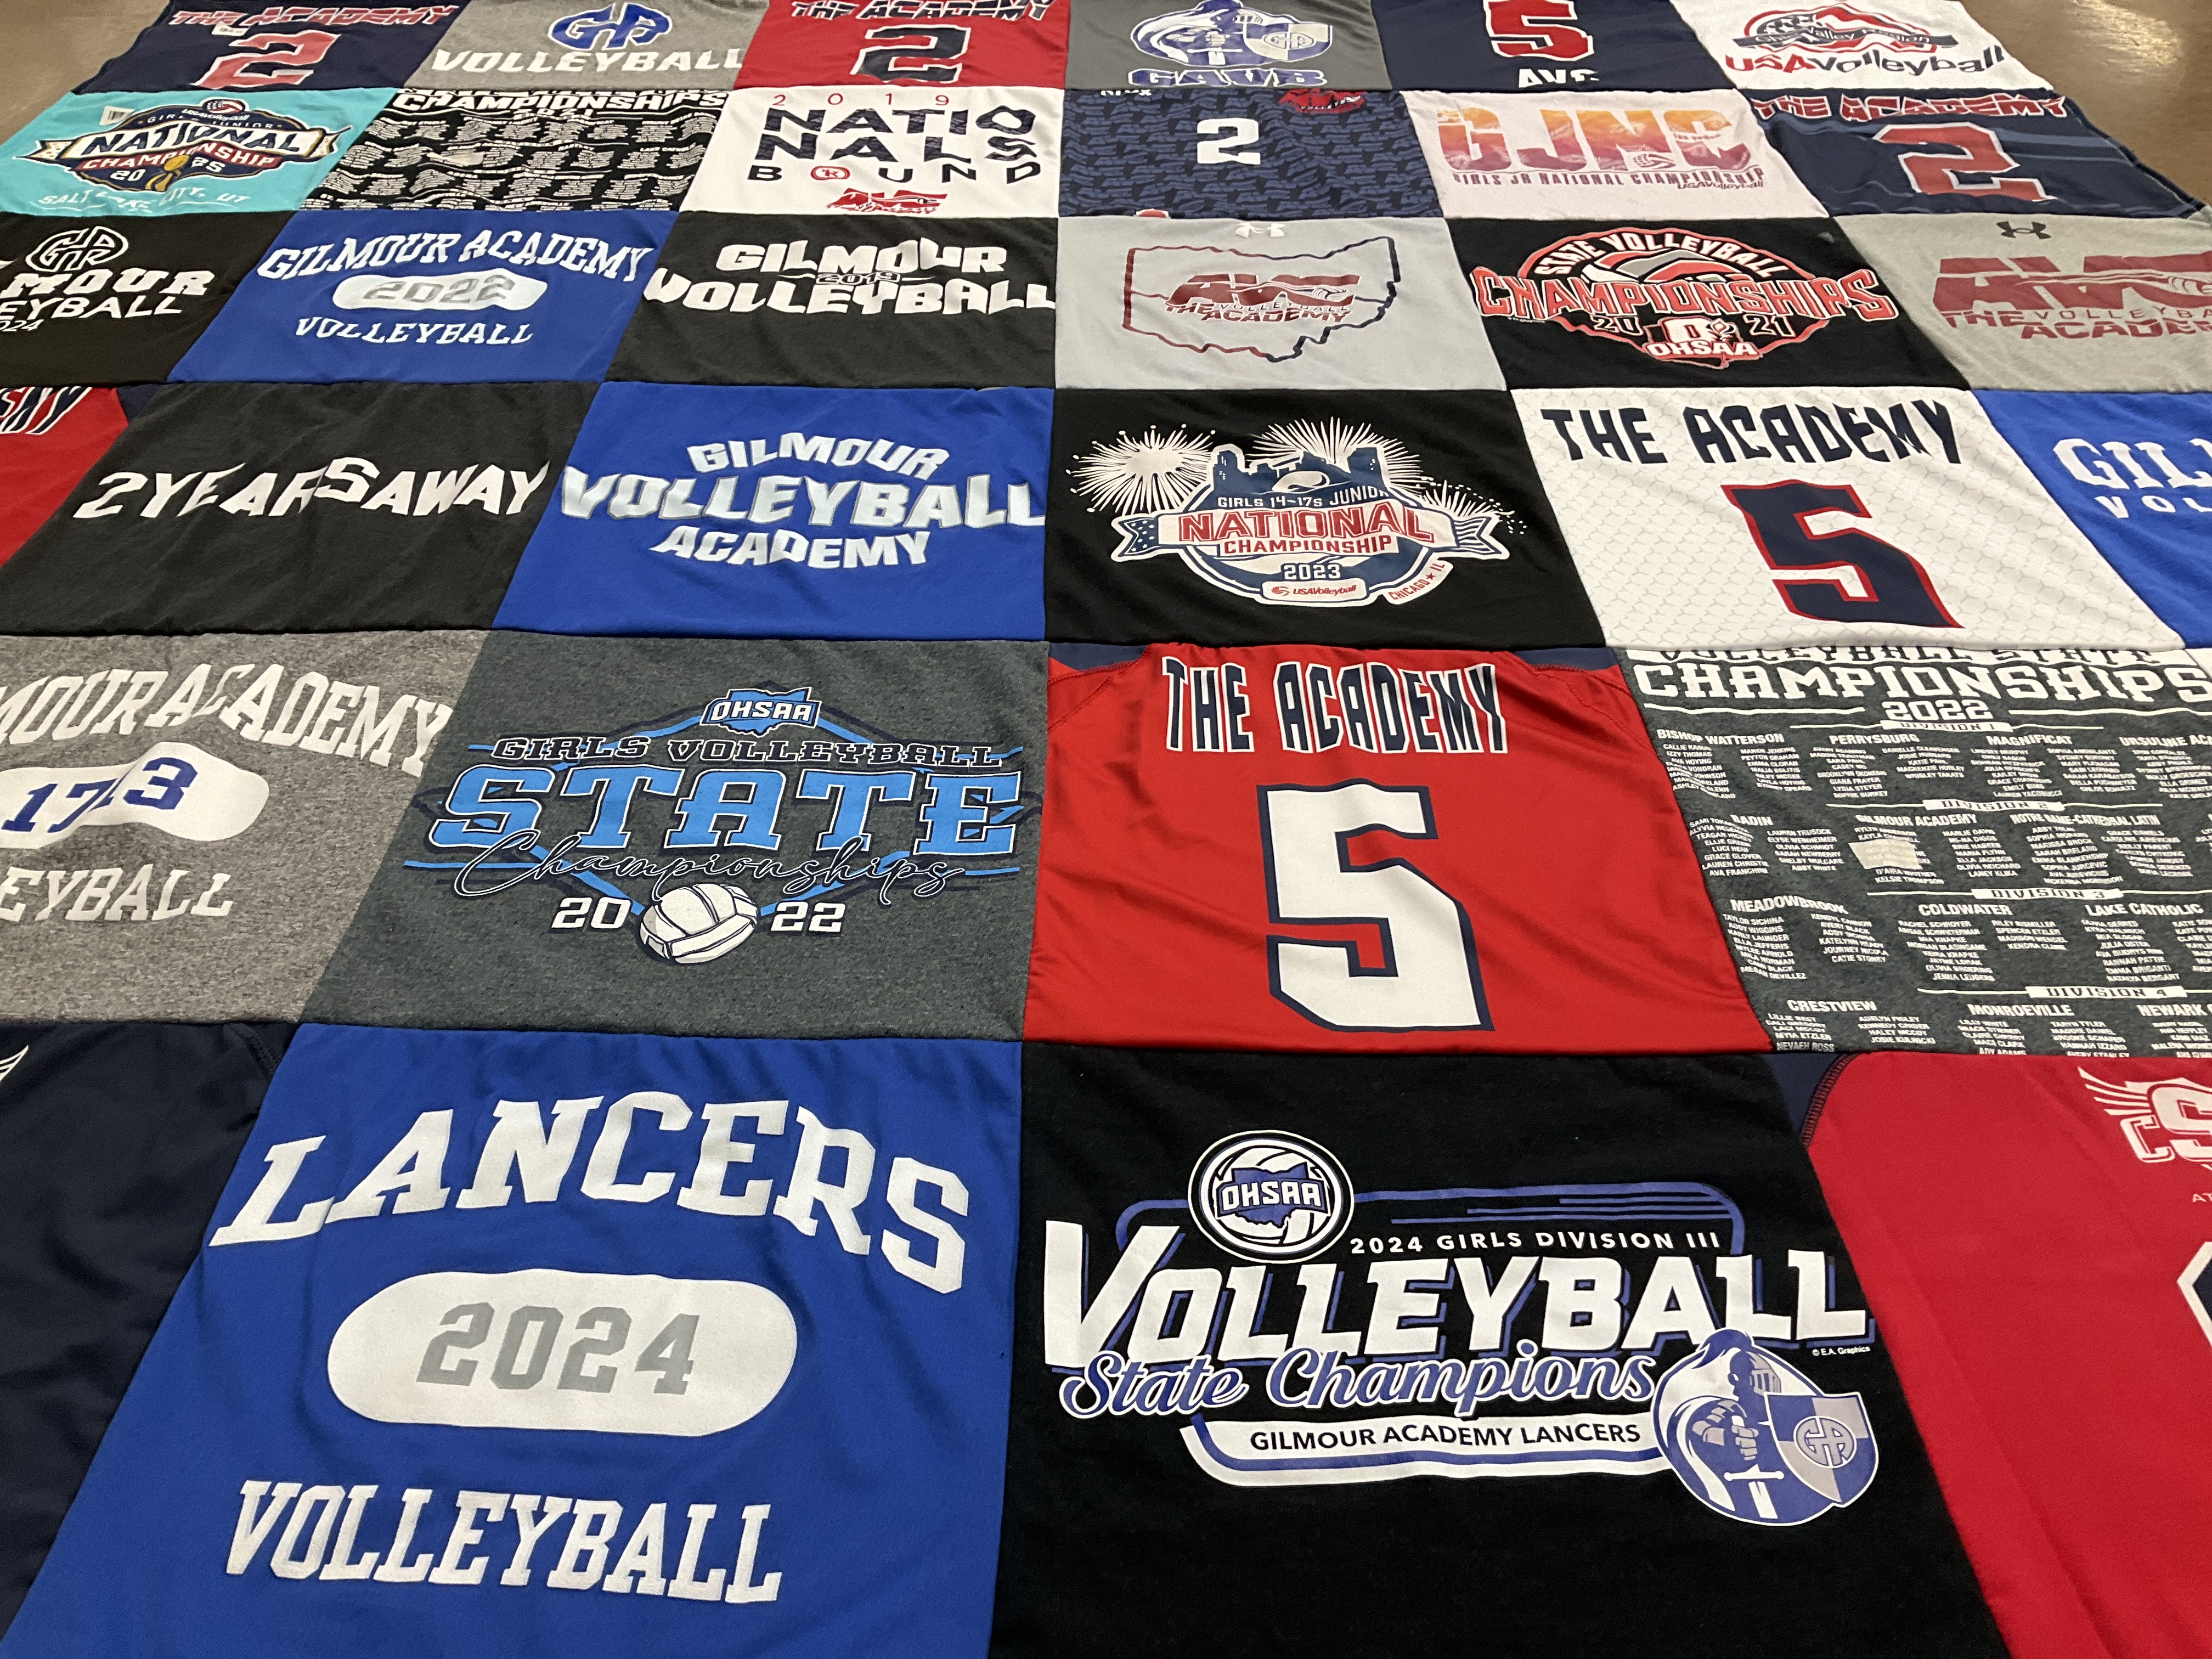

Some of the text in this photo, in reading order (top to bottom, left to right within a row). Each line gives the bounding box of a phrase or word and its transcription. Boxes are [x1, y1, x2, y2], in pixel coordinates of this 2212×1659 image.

[169, 5, 460, 26] THE ACADEMY
[791, 0, 1054, 21] THE ACADEMY
[1483, 0, 1594, 61] 5
[190, 29, 341, 89] 2
[431, 48, 743, 72] VOLLEYBALL
[850, 24, 970, 83] 2
[393, 92, 729, 110] CHAMPIONSHIPS
[1752, 93, 2067, 122] THE ACADEMY
[81, 125, 301, 155] NATIONAL
[1197, 117, 1261, 165] 2
[1871, 121, 2059, 202] 2
[110, 169, 145, 181] 20
[1510, 172, 1532, 185] JR
[1539, 173, 1624, 185] NATIONAL
[38, 189, 93, 204] SALT
[217, 193, 251, 203] UT
[257, 230, 655, 282] GILMOUR ACADEMY
[715, 237, 1007, 273] GILMOUR
[1535, 233, 1790, 279] STATE VOLLEYBALL
[363, 274, 514, 304] 2022
[815, 271, 901, 285] 2019
[642, 268, 1056, 315] VOLLEYBALL
[1470, 266, 1899, 323] CHAMPIONSHIPS
[1165, 303, 1353, 323] THE ACADEMY
[1592, 313, 1796, 337] 20 21
[1941, 311, 2029, 328] THE
[296, 317, 533, 345] VOLLEYBALL
[1647, 341, 1758, 356] OHSAA
[1541, 399, 1962, 465] THE ACADEMY
[686, 432, 950, 481] GILMOUR
[561, 466, 1046, 529] VOLLEYBALL
[1217, 496, 1263, 507] GIRLS
[1178, 504, 1435, 544] NATIONAL
[650, 526, 931, 569] ACADEMY
[1223, 534, 1392, 555] CHAMPIONSHIP
[1719, 478, 1966, 629] 5
[1283, 563, 1342, 580] 2023
[1388, 579, 1429, 601] CHICAGO
[1634, 662, 2212, 703] CHAMPIONSHIPS
[710, 699, 813, 724] OHSAA
[1161, 655, 1508, 754] THE ACADEMY
[1882, 700, 1994, 721] 2022
[144, 663, 454, 777] ACADEMY
[1900, 722, 1987, 731] DIVISION
[1656, 729, 1785, 745] BISHOP WATTERSON
[1829, 733, 1920, 744] PERRYSBURG
[1985, 735, 2073, 746] MAGNIFICAT
[2119, 736, 2188, 747] URSULINE
[491, 736, 1003, 769] GIRLS VOLLEYBALL
[428, 763, 1022, 856] STATE
[1940, 800, 2024, 809] DIVISION
[1730, 814, 1774, 826] BADIN
[1855, 814, 1978, 826] GILMOUR ACADEMY
[2010, 814, 2045, 825] NOTRE
[2130, 815, 2161, 825] LATIN
[454, 828, 965, 906] Championships
[1255, 777, 1495, 1031] 5
[1730, 895, 1849, 915] MEADOWBROOK
[1991, 890, 2085, 899] DIVISION
[550, 897, 847, 935] 20 22
[1918, 904, 2013, 916] COLDWATER
[2085, 902, 2204, 916] LAKE CATHOLIC
[2046, 988, 2148, 997] DIVISION
[1787, 1000, 1877, 1012] CRESTVIEW
[1967, 1004, 2075, 1017] MONROEVILLE
[2136, 1004, 2208, 1017] NEWARK
[209, 1091, 969, 1294] LANCERS
[1221, 1180, 1323, 1209] OHSAA
[1350, 1231, 1720, 1254] 2024 GIRLS DIVISION III
[1044, 1219, 1866, 1368] VOLLEYBALL
[417, 1303, 698, 1396] 2024
[1837, 1346, 1871, 1355] Graphics
[1059, 1339, 1658, 1419] State Champions
[1250, 1423, 1641, 1451] GILMOUR ACADEMY LANCERS
[227, 1481, 783, 1604] VOLLEYBALL
